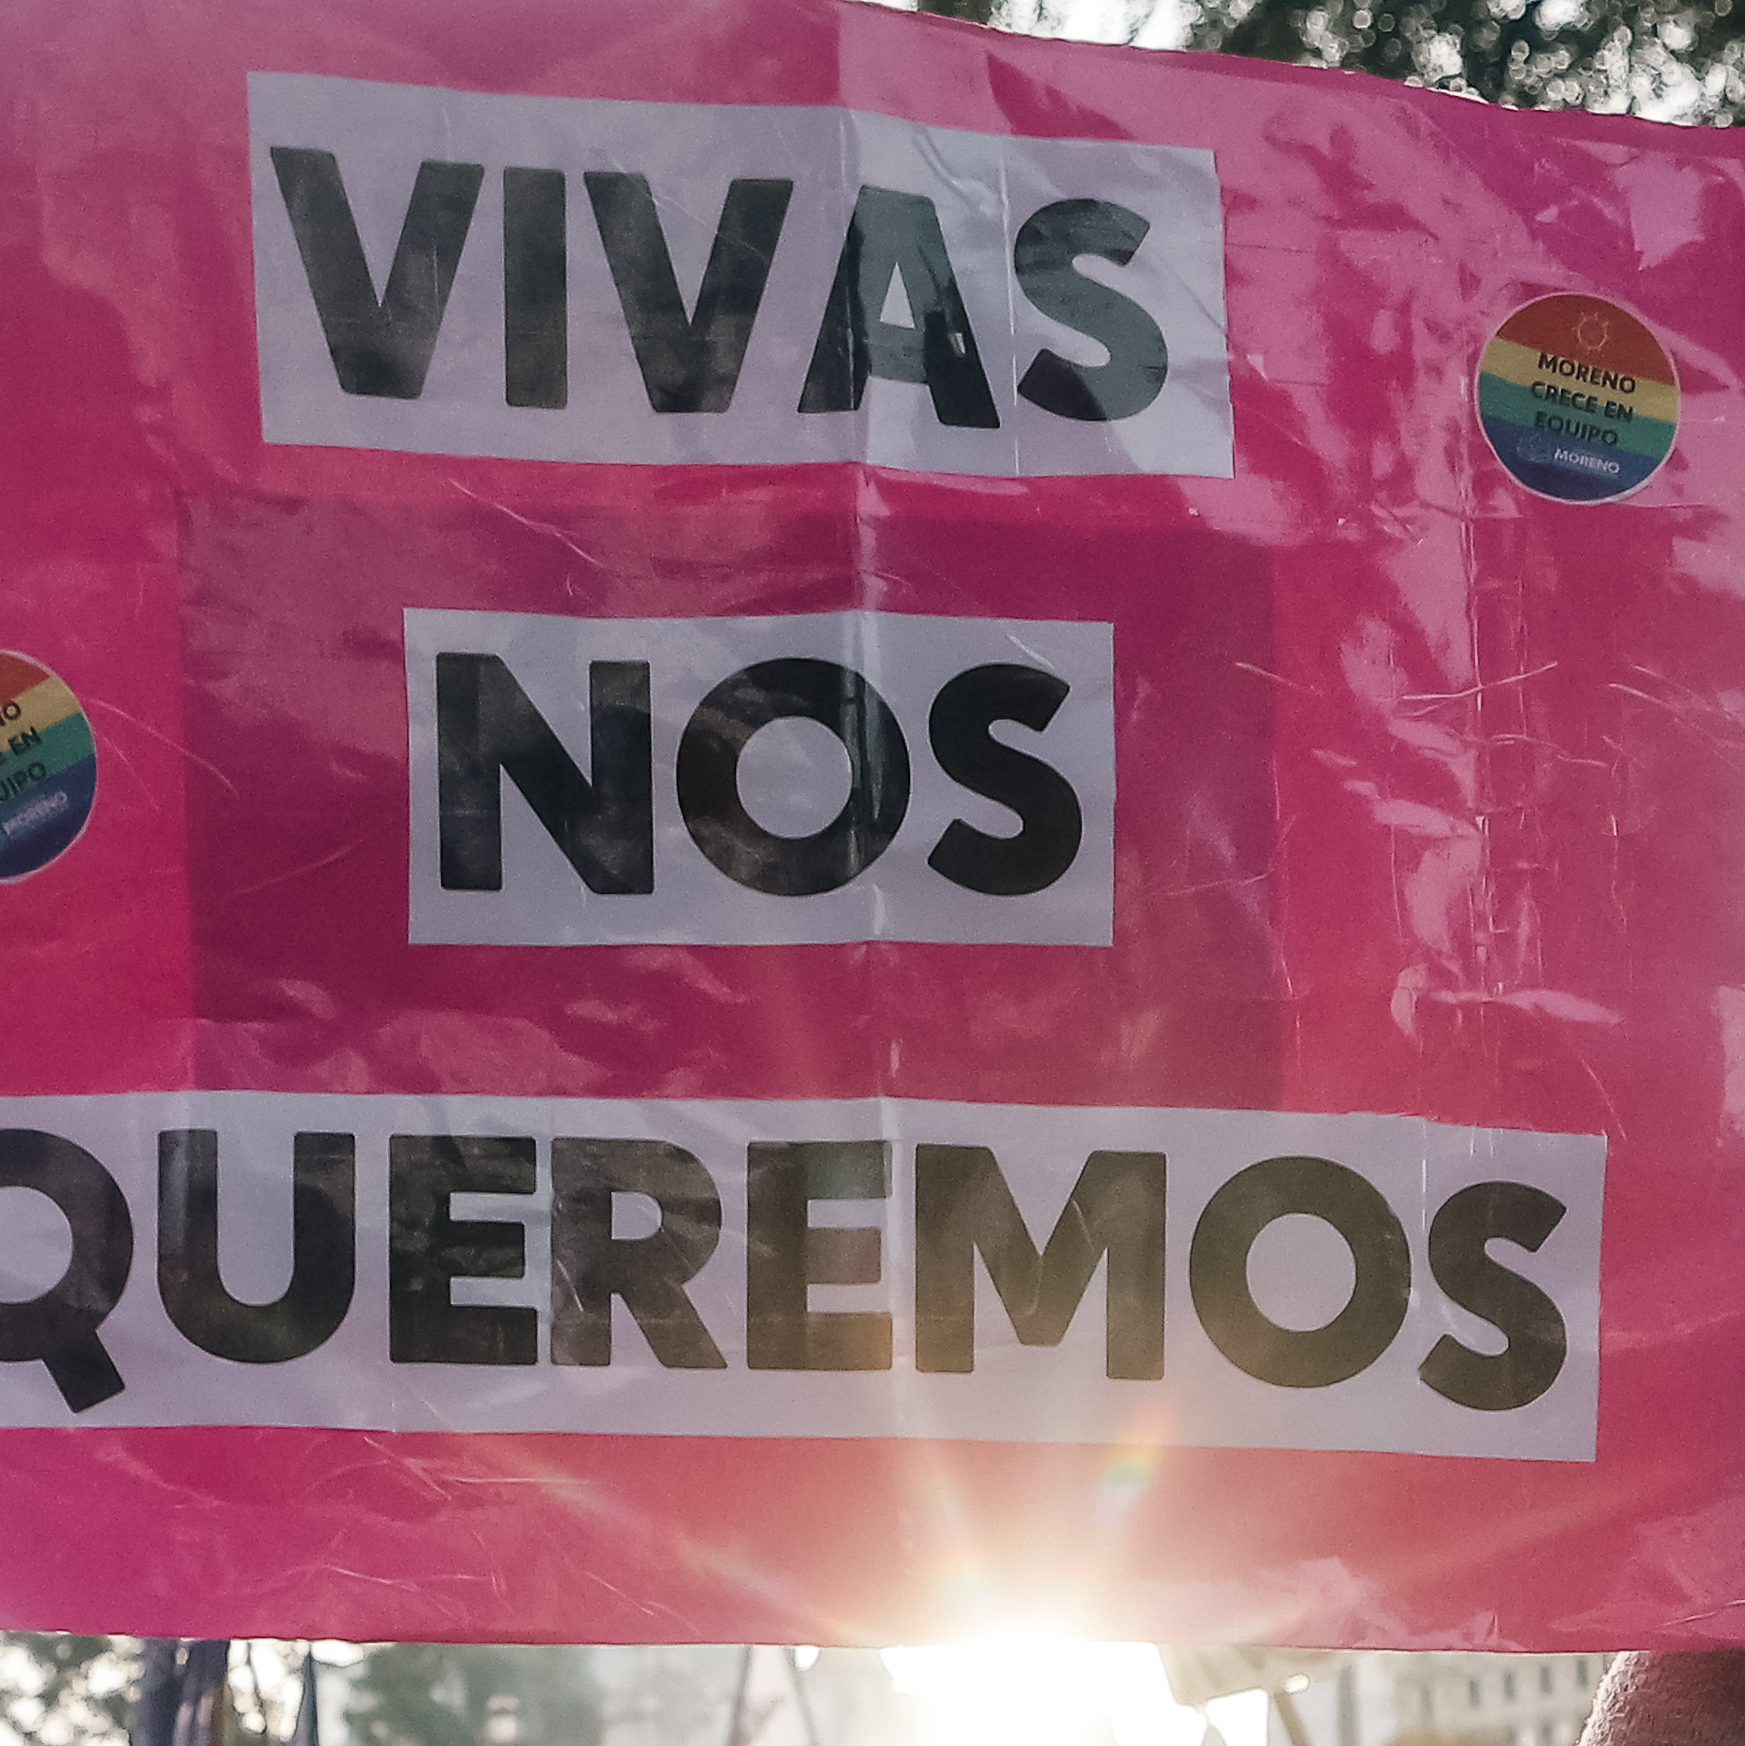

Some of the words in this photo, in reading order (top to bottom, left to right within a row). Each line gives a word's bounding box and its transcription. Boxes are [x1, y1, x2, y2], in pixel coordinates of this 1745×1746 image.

[271, 147, 1168, 428] VIVAS
[1538, 353, 1635, 394] MORENO
[1531, 381, 1598, 414] CRECE
[1604, 401, 1633, 423] EN
[1534, 411, 1618, 446] EQUIPO
[1554, 449, 1620, 474] MORENO
[8, 726, 41, 756] EN
[436, 651, 1082, 896] NOS
